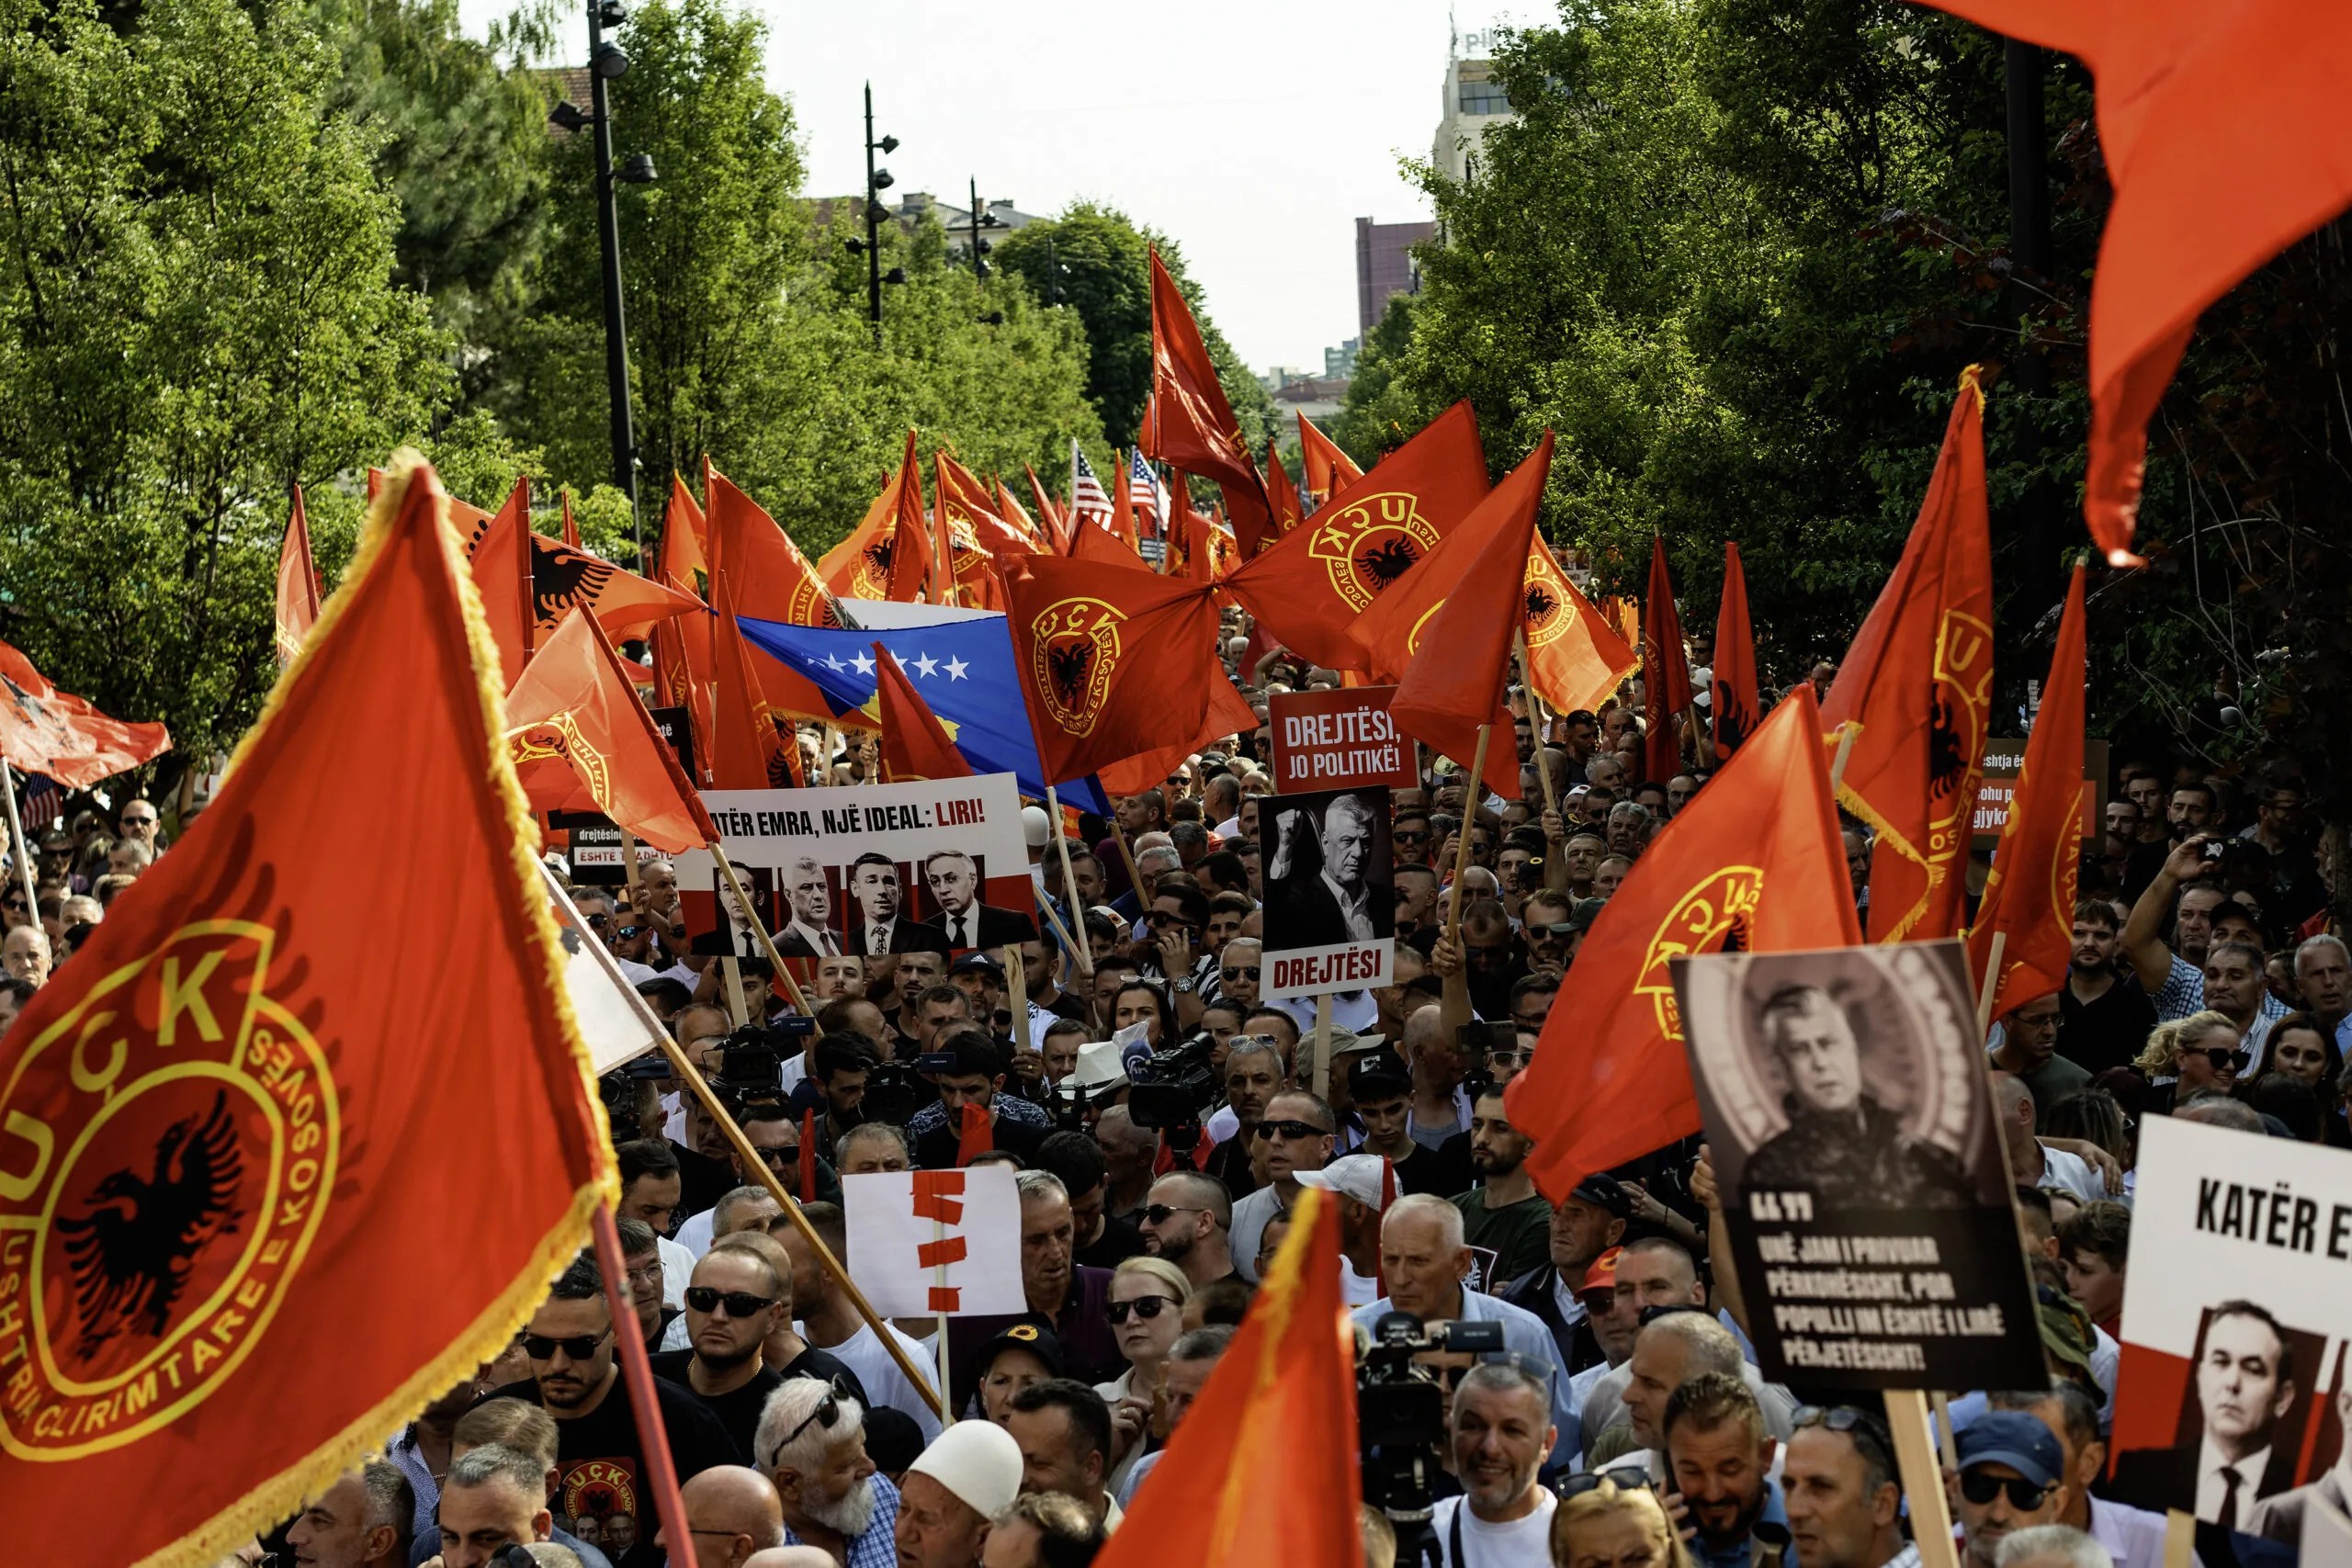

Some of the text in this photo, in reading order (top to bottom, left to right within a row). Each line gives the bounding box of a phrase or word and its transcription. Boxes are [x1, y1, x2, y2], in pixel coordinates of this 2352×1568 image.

[1285, 706, 1401, 748] DREJTËSI,
[1288, 744, 1401, 780] JO POLITIKË!
[1978, 785, 2003, 801] ohu
[757, 810, 820, 839] EMRA,
[822, 804, 862, 834] NJË
[865, 804, 933, 830] IDEAL:
[935, 798, 985, 827] LIRI!
[580, 848, 616, 862] ËSHTË
[1272, 947, 1382, 989] DREJTËSI
[0, 950, 228, 1202] UÇK
[248, 1028, 321, 1226] KOSOVËS
[2196, 1177, 2352, 1261] KATËR E
[259, 1238, 289, 1265] E
[31, 1278, 267, 1443] ÇLIRIMTARE
[569, 1464, 624, 1486] UÇK
